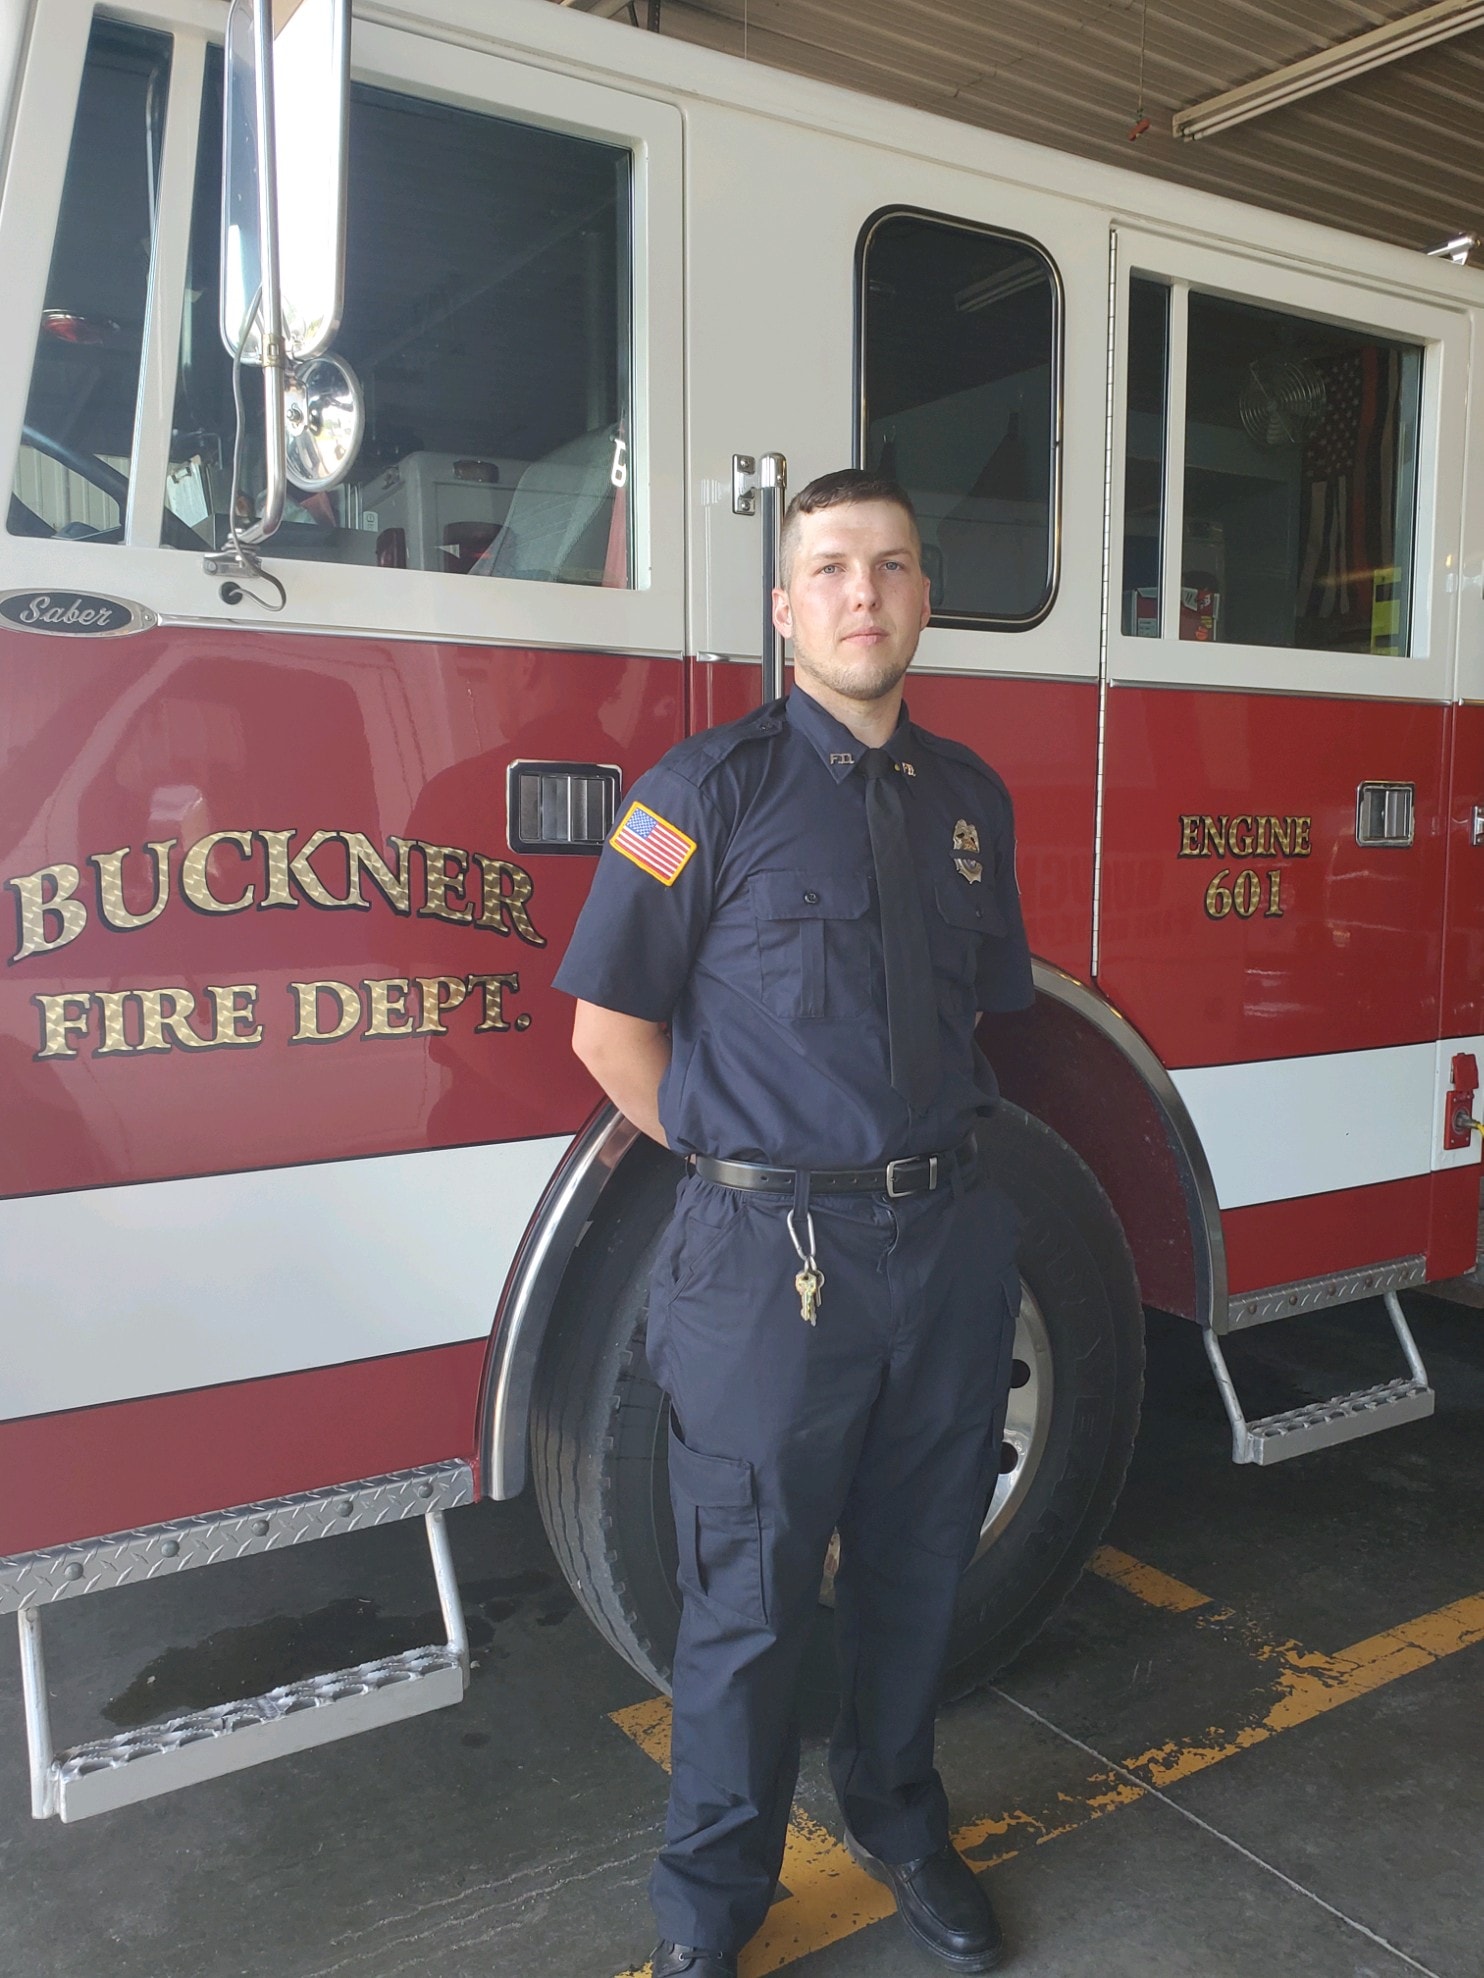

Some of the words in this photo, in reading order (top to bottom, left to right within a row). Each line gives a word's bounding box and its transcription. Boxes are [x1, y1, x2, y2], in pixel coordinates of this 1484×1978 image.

[19, 596, 112, 625] Saber
[1177, 815, 1312, 859] ENGINE
[7, 829, 546, 965] BUCKNER
[1205, 869, 1284, 920] 601
[33, 983, 264, 1060] FIRE
[288, 973, 532, 1046] DEPT.
